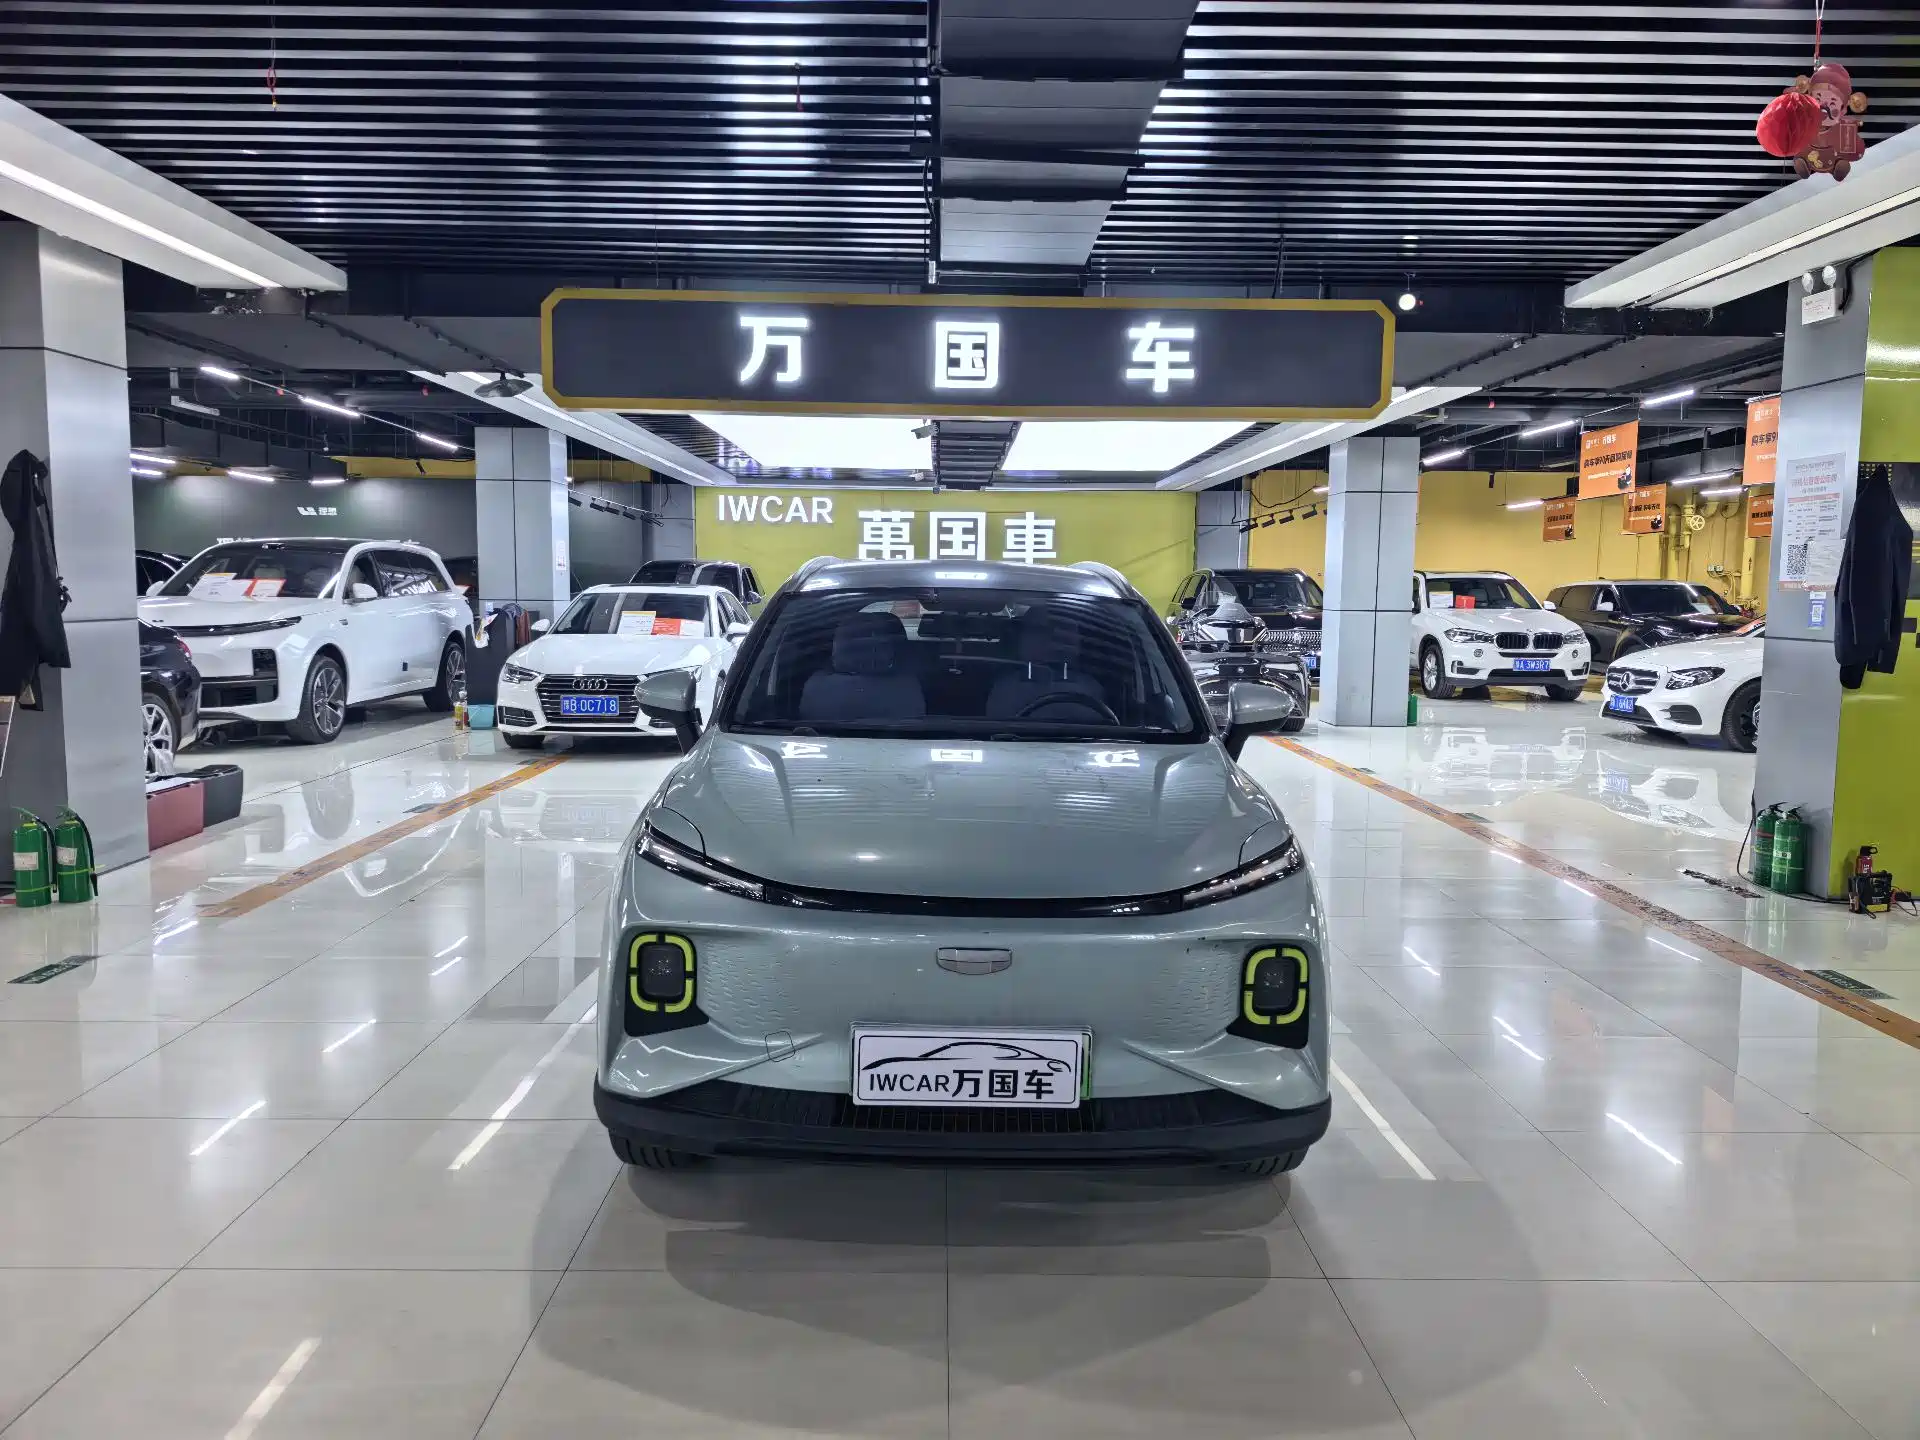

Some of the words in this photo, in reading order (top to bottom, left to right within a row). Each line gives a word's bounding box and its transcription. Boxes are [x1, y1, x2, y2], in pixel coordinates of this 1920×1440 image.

[739, 315, 1196, 394] 万国车
[717, 494, 834, 524] IWCAR
